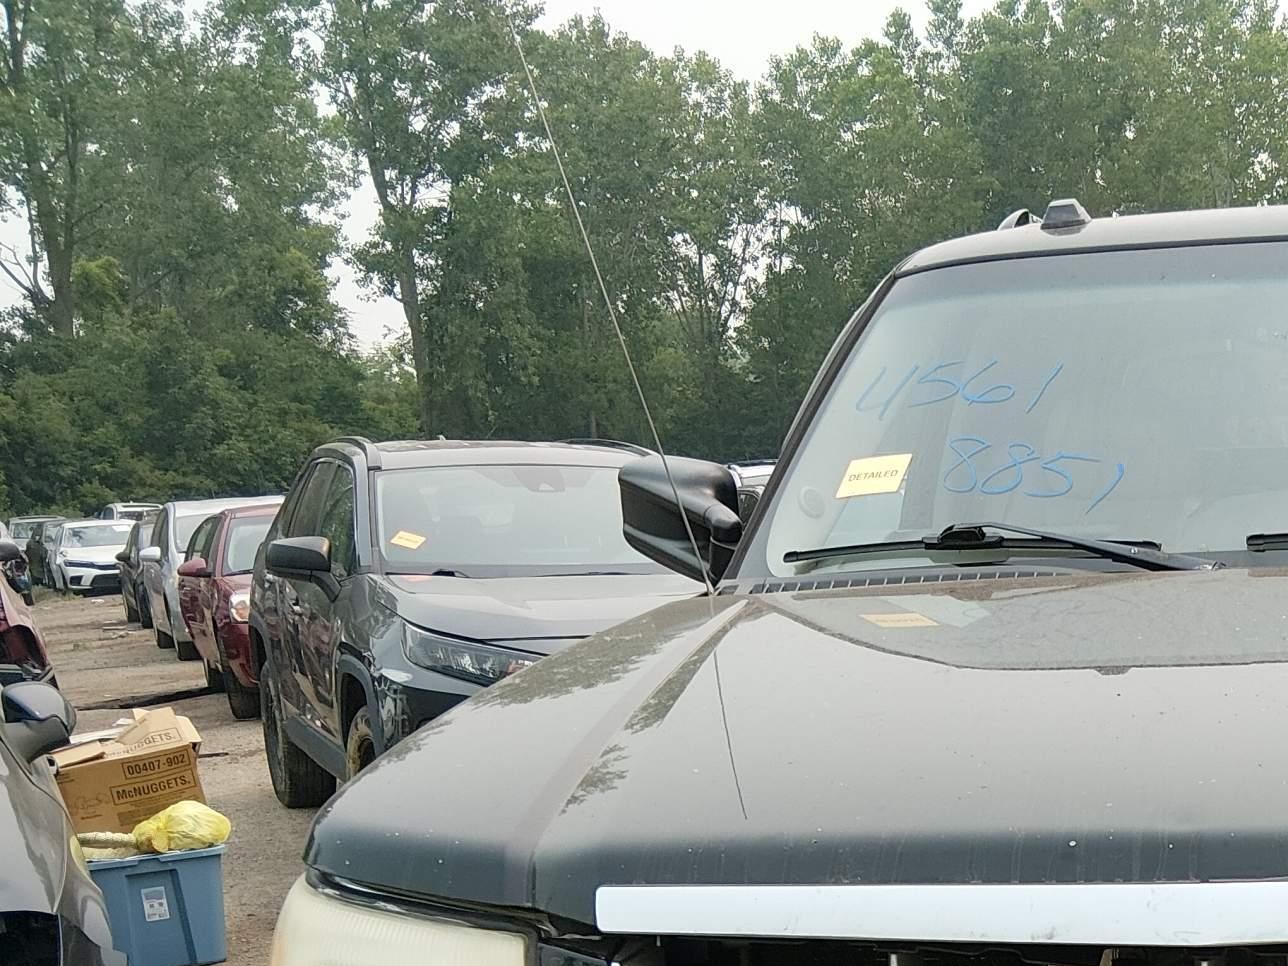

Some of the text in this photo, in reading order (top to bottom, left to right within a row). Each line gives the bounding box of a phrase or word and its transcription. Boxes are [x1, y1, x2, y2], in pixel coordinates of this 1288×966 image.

[855, 360, 1064, 421] 4561
[848, 469, 899, 482] DETAILED
[943, 437, 1125, 515] 8851
[127, 754, 185, 776] 00407-902
